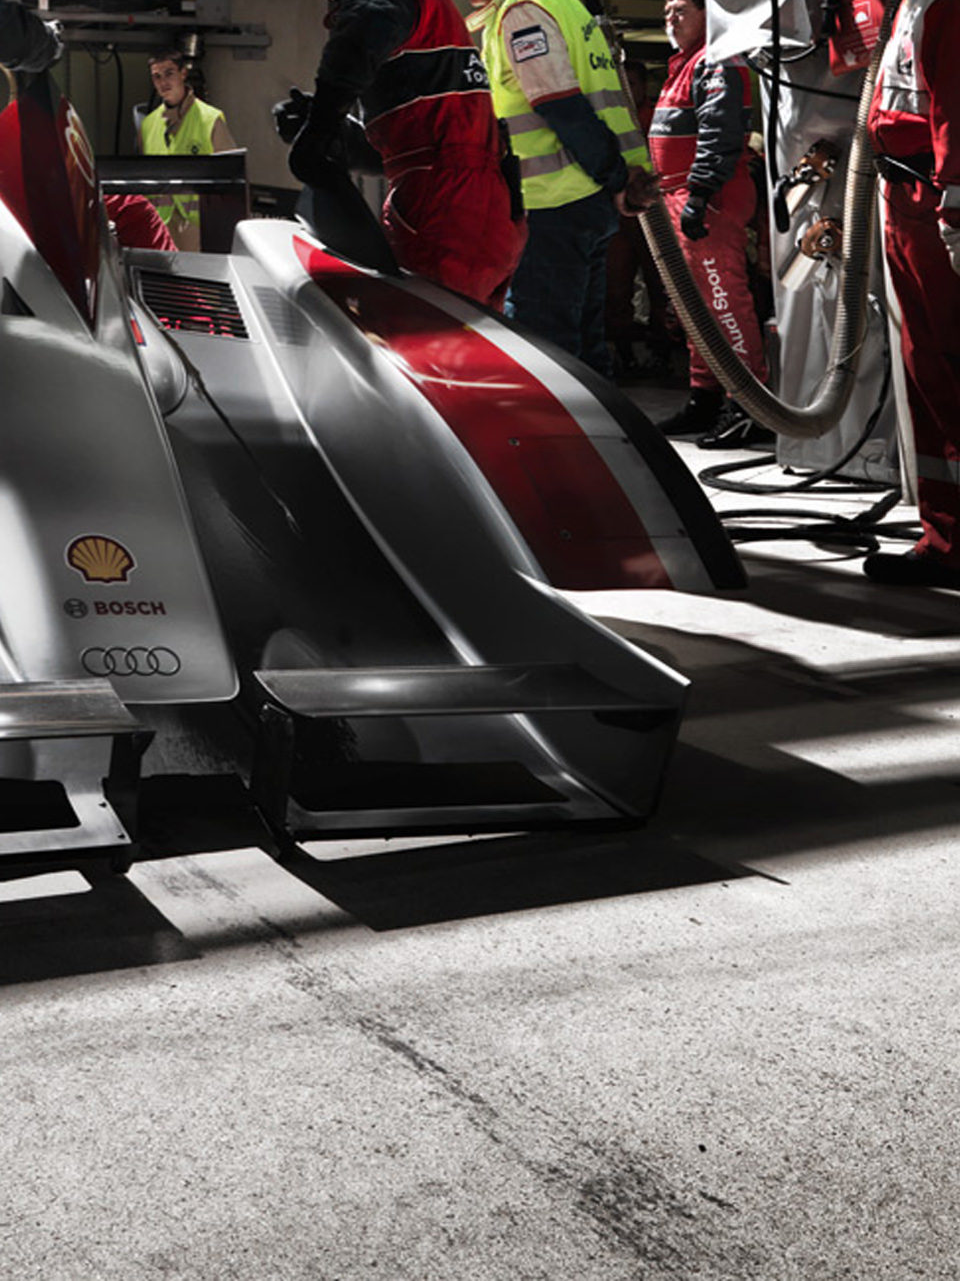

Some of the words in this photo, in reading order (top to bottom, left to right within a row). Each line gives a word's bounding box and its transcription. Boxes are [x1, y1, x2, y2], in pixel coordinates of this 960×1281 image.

[702, 256, 729, 311] Sport
[718, 311, 749, 355] Audi
[93, 600, 168, 617] BOSCH
